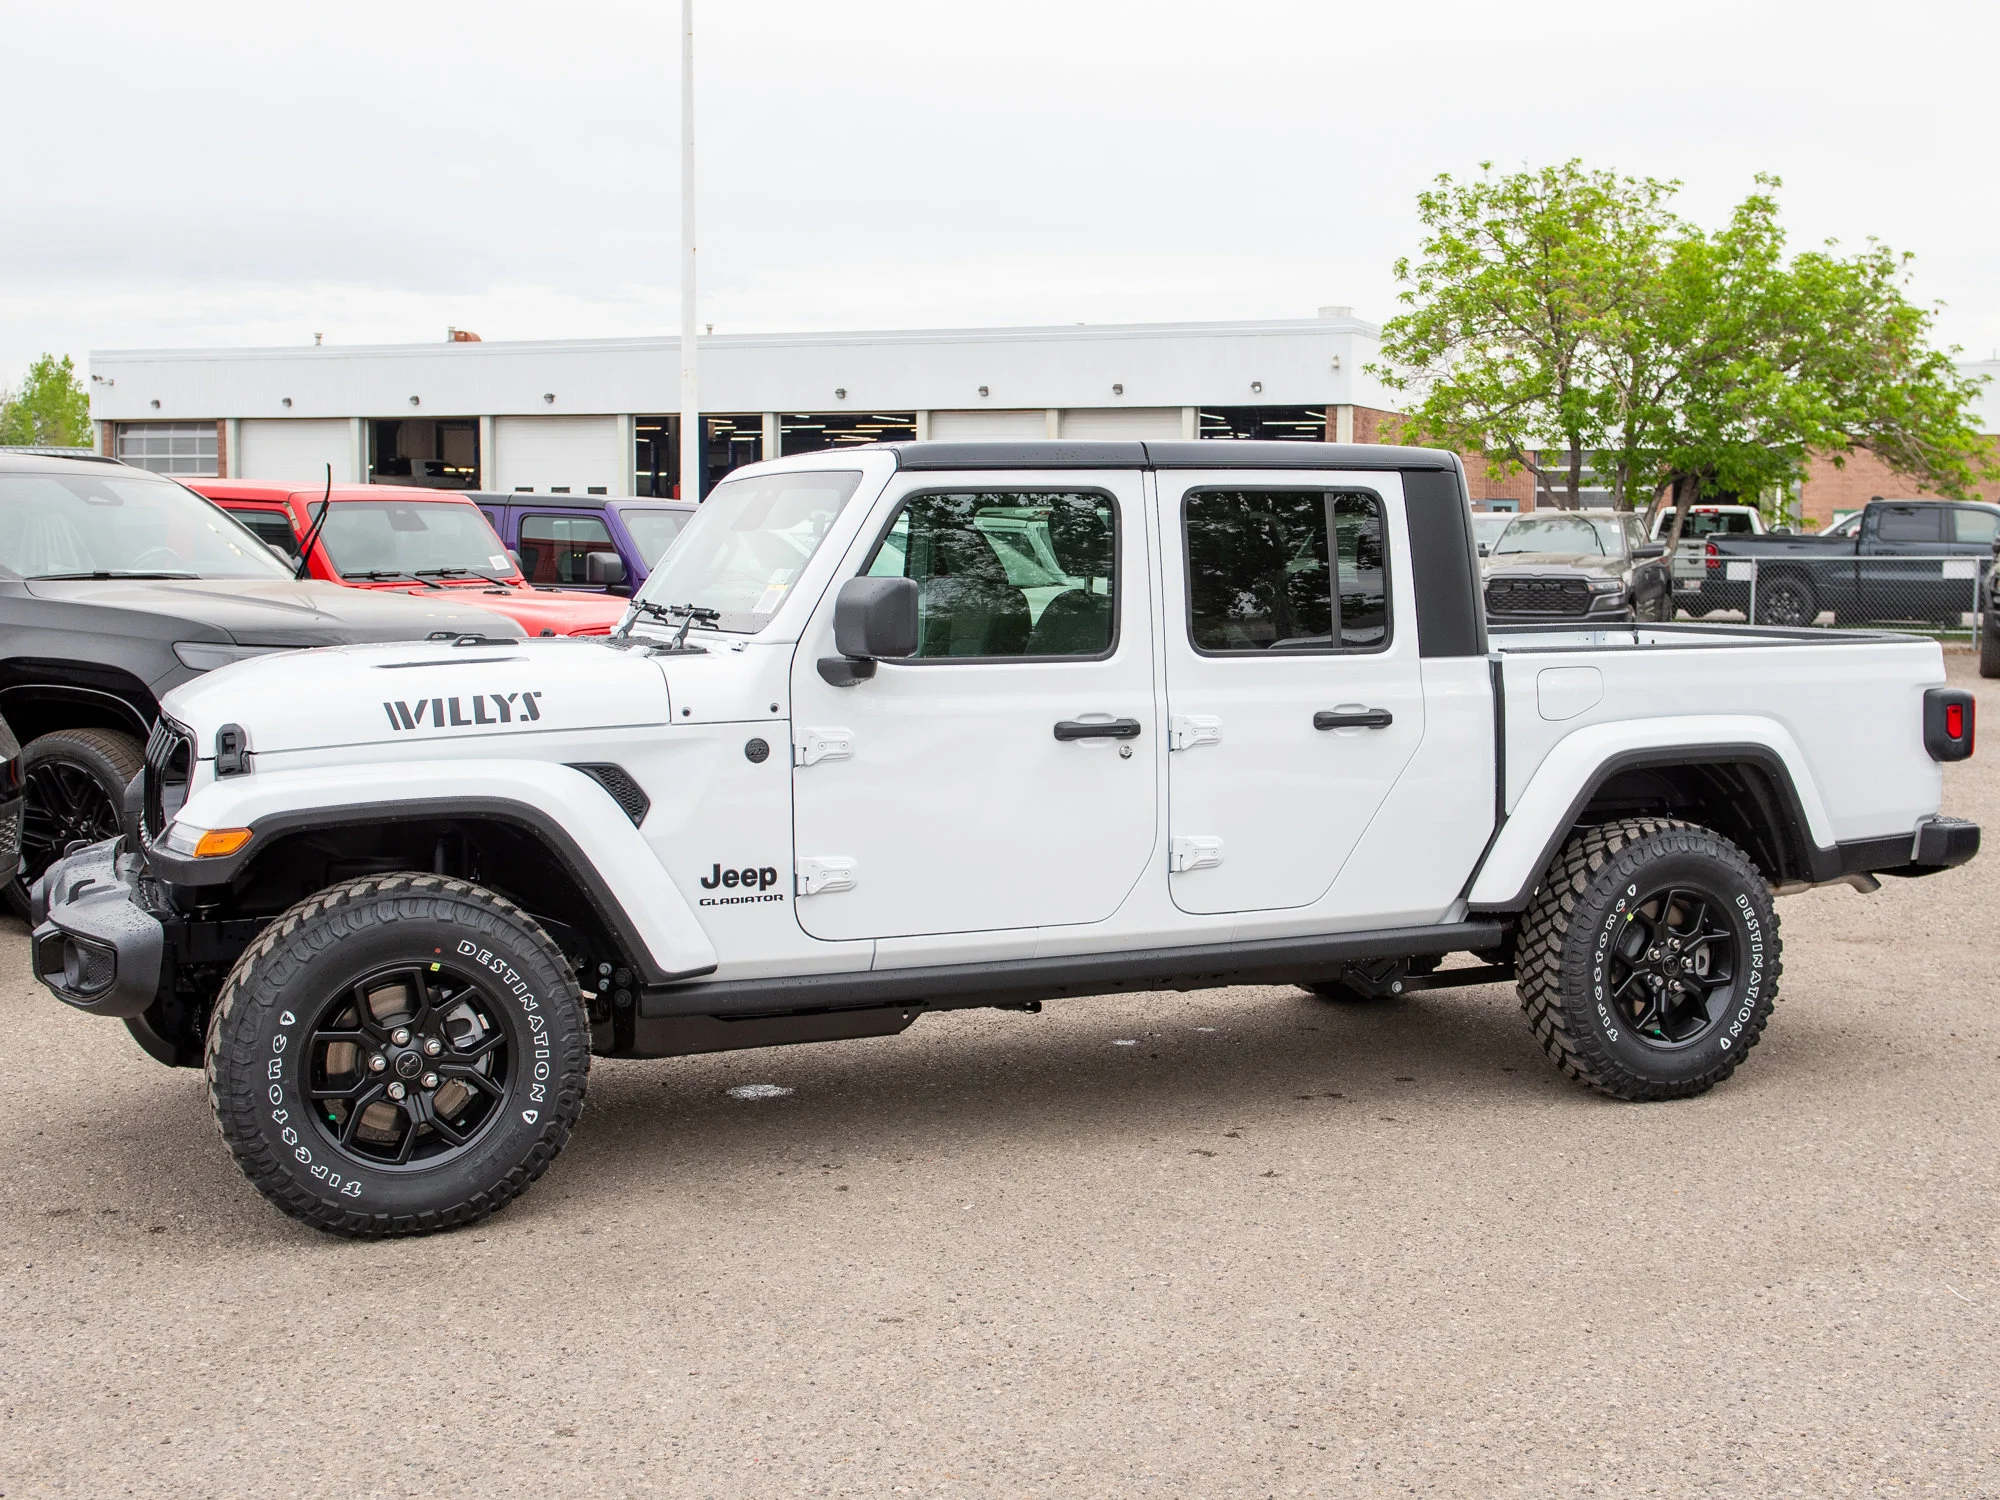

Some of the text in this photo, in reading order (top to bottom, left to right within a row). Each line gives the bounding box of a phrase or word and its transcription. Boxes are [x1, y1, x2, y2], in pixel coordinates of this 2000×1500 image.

[383, 692, 542, 730] WILLYS
[699, 894, 784, 906] GLADIATOR
[700, 863, 777, 891] Jeep
[456, 939, 550, 1103] DESTINATION
[1593, 898, 1626, 1042] Firestone
[1729, 894, 1763, 1037] DESTINATION
[268, 1034, 362, 1198] Firestone
